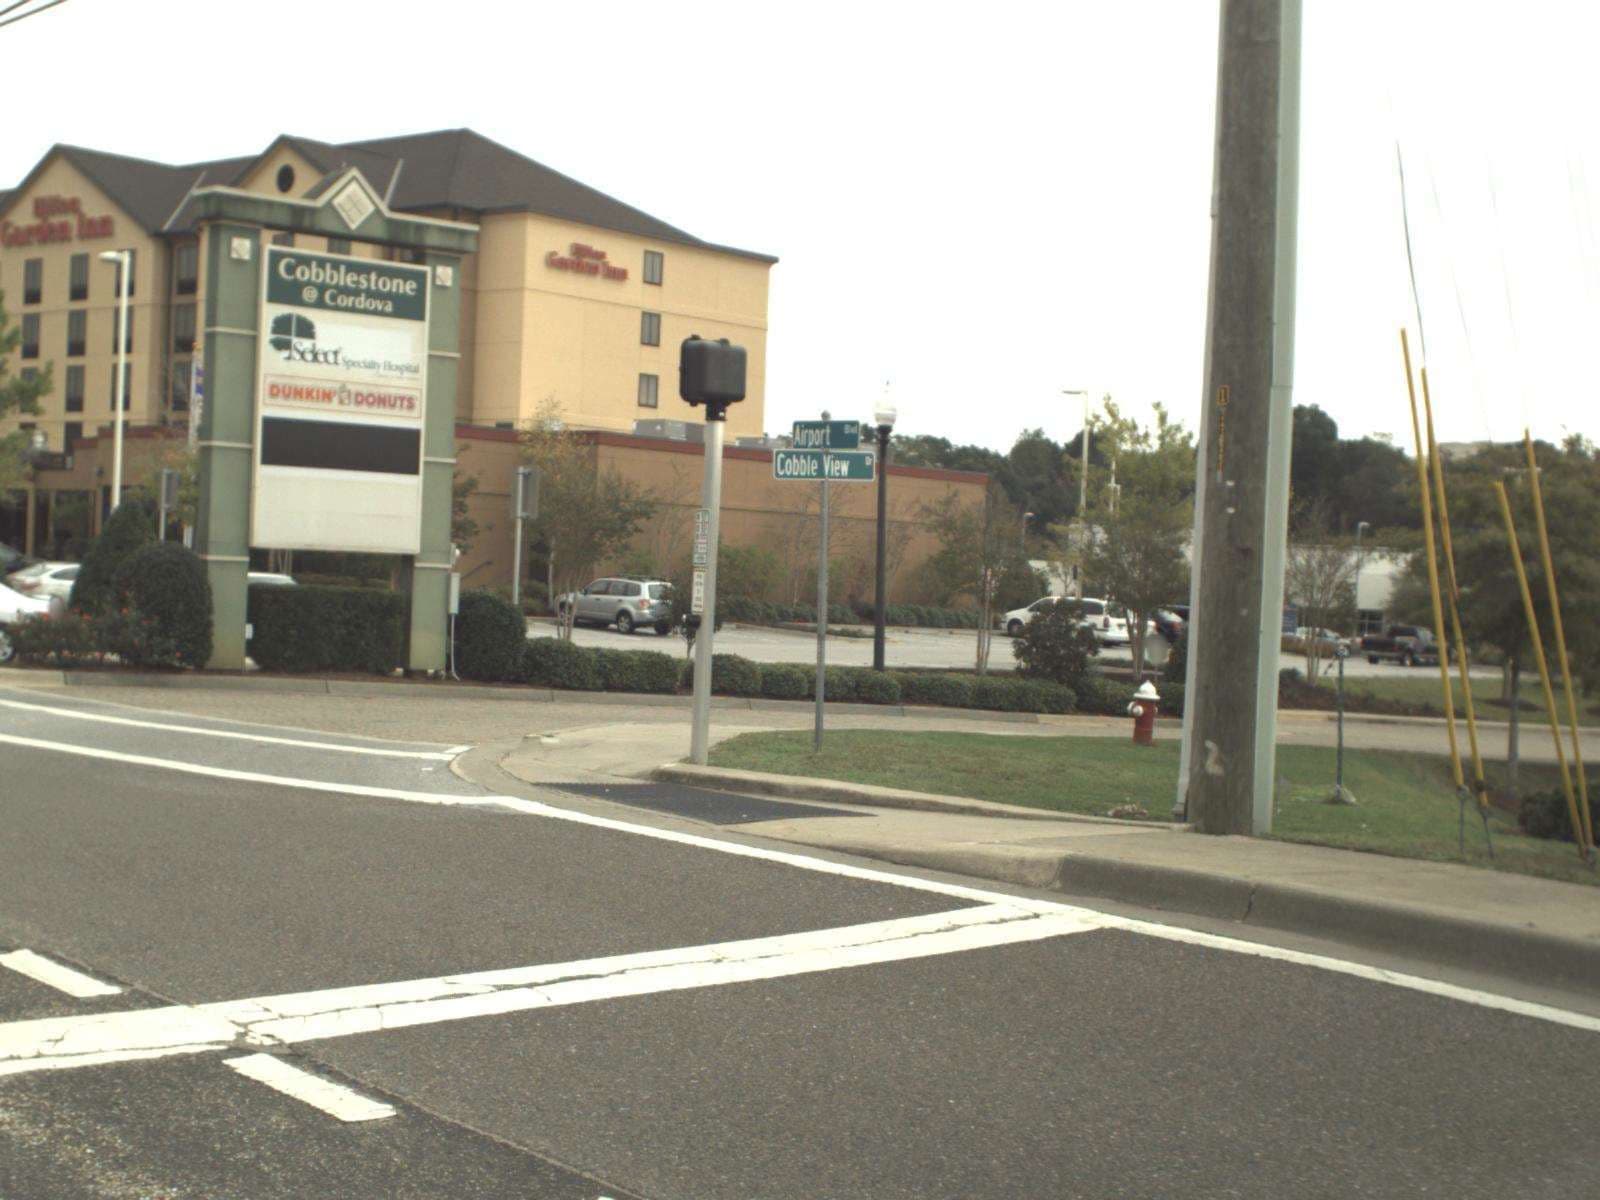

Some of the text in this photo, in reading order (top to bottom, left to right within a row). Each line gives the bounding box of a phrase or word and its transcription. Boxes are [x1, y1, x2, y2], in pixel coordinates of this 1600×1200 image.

[278, 257, 417, 296] Cobblestone
[302, 286, 394, 313] @ Cordova
[292, 341, 341, 366] Select
[384, 360, 420, 376] Hospital
[269, 383, 416, 410] DUNKIN' DONUTS
[794, 424, 831, 448] Airport
[777, 453, 818, 476] Cobble
[823, 454, 850, 477] View
